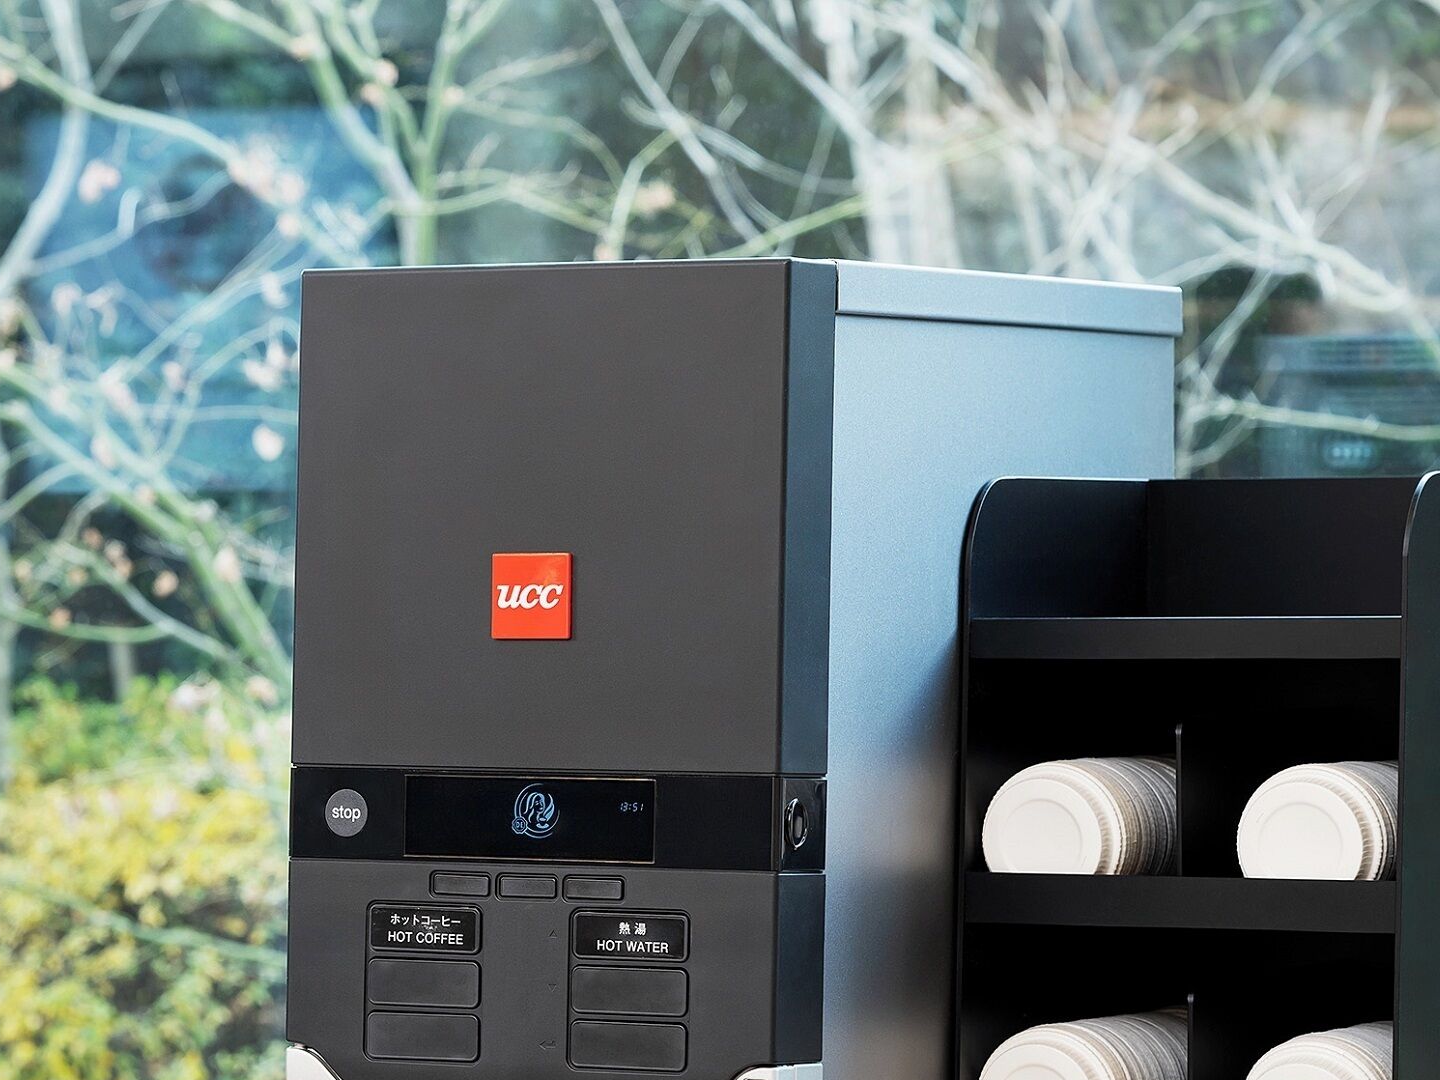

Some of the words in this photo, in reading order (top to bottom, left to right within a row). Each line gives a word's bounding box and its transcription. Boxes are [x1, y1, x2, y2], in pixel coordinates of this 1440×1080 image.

[331, 804, 361, 823] stop
[620, 801, 644, 813] 13:51
[390, 913, 461, 928] ホットコーヒー
[387, 930, 414, 943] HOT
[415, 931, 464, 946] COFFEE
[596, 939, 624, 952] HOT
[625, 940, 669, 954] WATER
